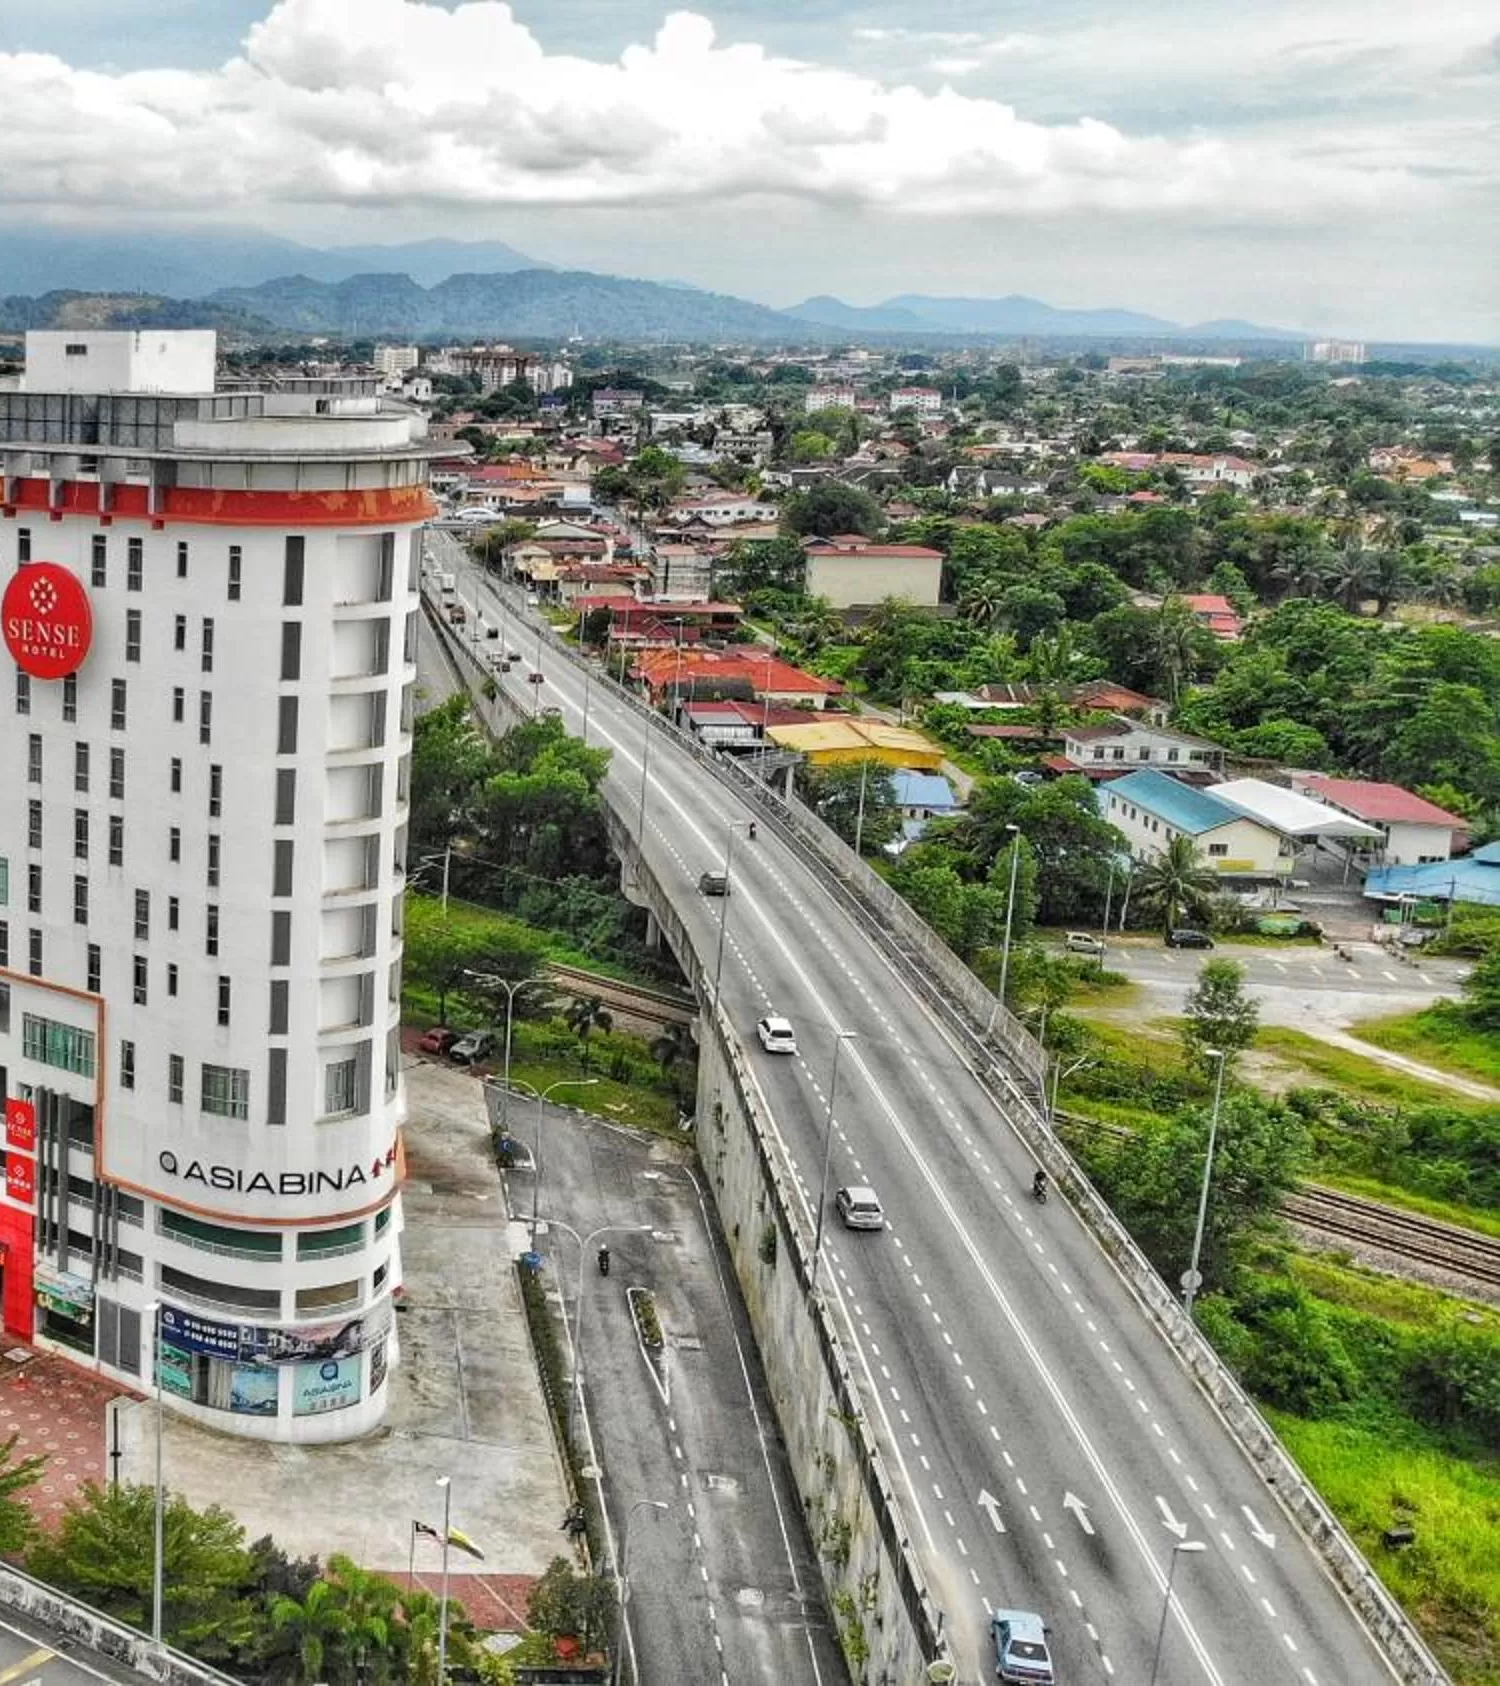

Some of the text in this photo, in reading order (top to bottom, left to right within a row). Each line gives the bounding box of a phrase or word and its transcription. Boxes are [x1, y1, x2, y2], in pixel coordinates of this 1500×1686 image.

[8, 616, 79, 648] SENSE
[21, 643, 65, 659] HOTEL
[183, 1160, 367, 1195] ASIABINA
